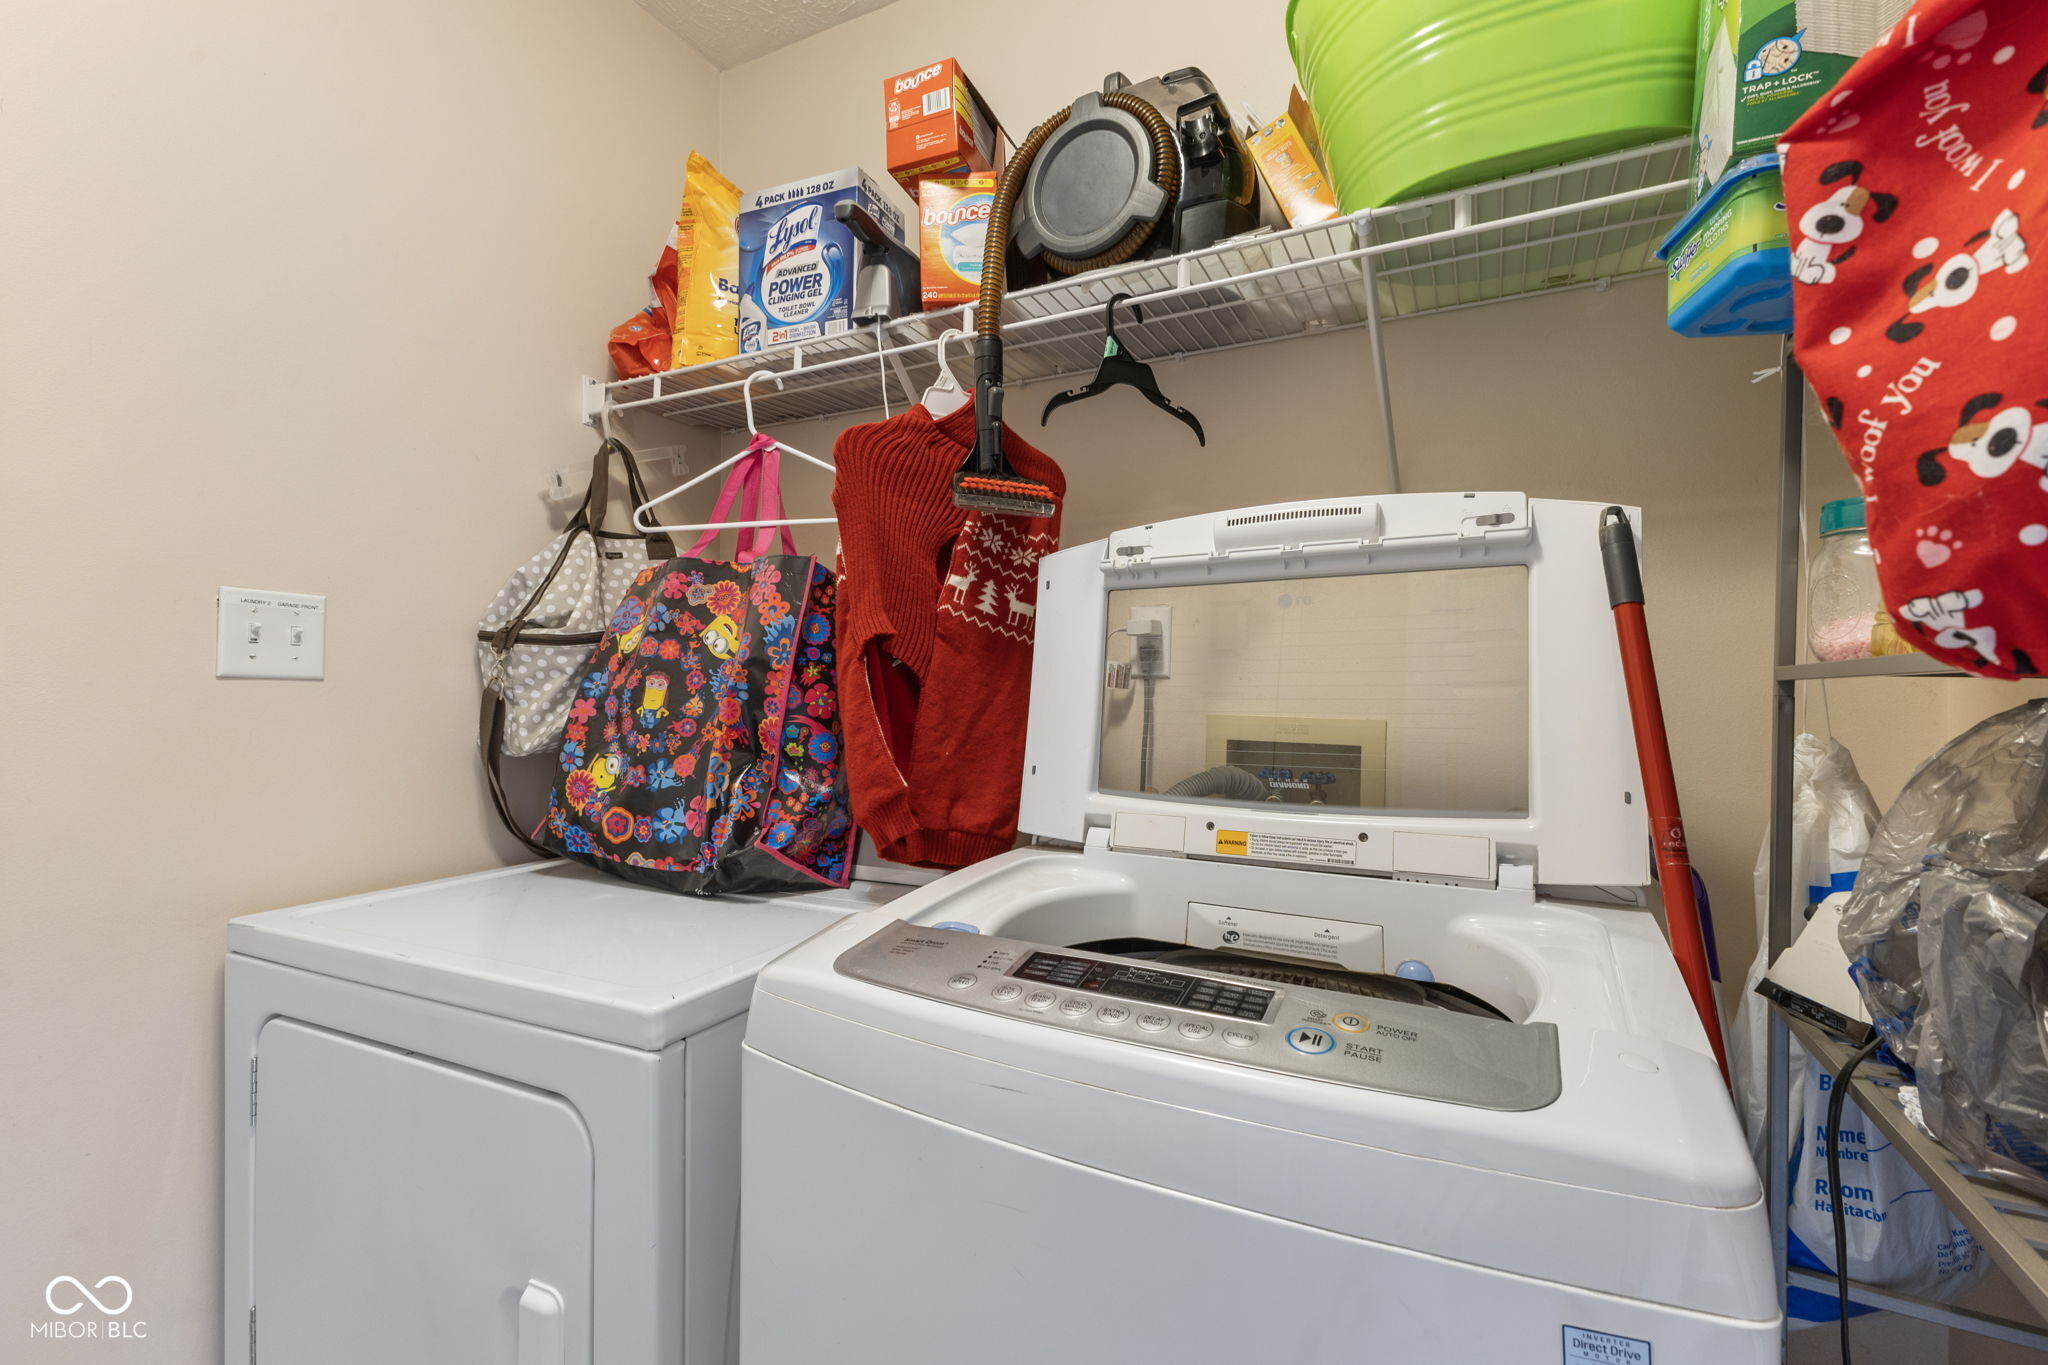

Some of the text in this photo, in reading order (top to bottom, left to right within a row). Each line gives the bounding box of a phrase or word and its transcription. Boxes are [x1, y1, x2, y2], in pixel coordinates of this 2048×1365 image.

[895, 63, 942, 94] bounce
[1742, 81, 1772, 94] TRAP
[1915, 79, 2004, 192] I woof you
[755, 181, 835, 208] 4 PACK 128 OZ
[861, 178, 868, 193] 4
[867, 186, 882, 205] PACK
[923, 203, 991, 226] bounce
[769, 206, 818, 254] Lysol
[1703, 208, 1733, 242] MOPPING
[1706, 221, 1729, 247] CLOTHS
[1670, 238, 1701, 280] Swiffer
[778, 263, 817, 278] ADVANCED
[769, 273, 823, 297] POWER
[768, 288, 823, 306] CLINGING GEL
[923, 291, 938, 299] 240
[778, 301, 816, 313] TOILET BOWL
[783, 308, 809, 318] CLEANER
[772, 330, 788, 342] 2in1
[1880, 357, 1942, 415] you
[240, 597, 266, 606] LAUNDRY
[277, 601, 300, 609] GARAGE
[1314, 931, 1340, 941] Detergent
[1103, 1007, 1125, 1015] EXTRA
[1143, 1019, 1163, 1027] WASH
[1184, 1022, 1209, 1031] SPECIAL
[1187, 1027, 1201, 1035] USE
[1227, 1031, 1253, 1041] CYCLES
[1376, 1025, 1418, 1038] POWER
[1376, 1031, 1400, 1040] AUTO
[1343, 1050, 1383, 1063] PAUSE
[1345, 1043, 1384, 1055] START
[1817, 1125, 1866, 1145] Nme
[1816, 1146, 1869, 1162] Nmbre
[1815, 1178, 1874, 1203] Rom
[1582, 1333, 1631, 1348] INVERTER
[1572, 1337, 1641, 1361] Direct Drive
